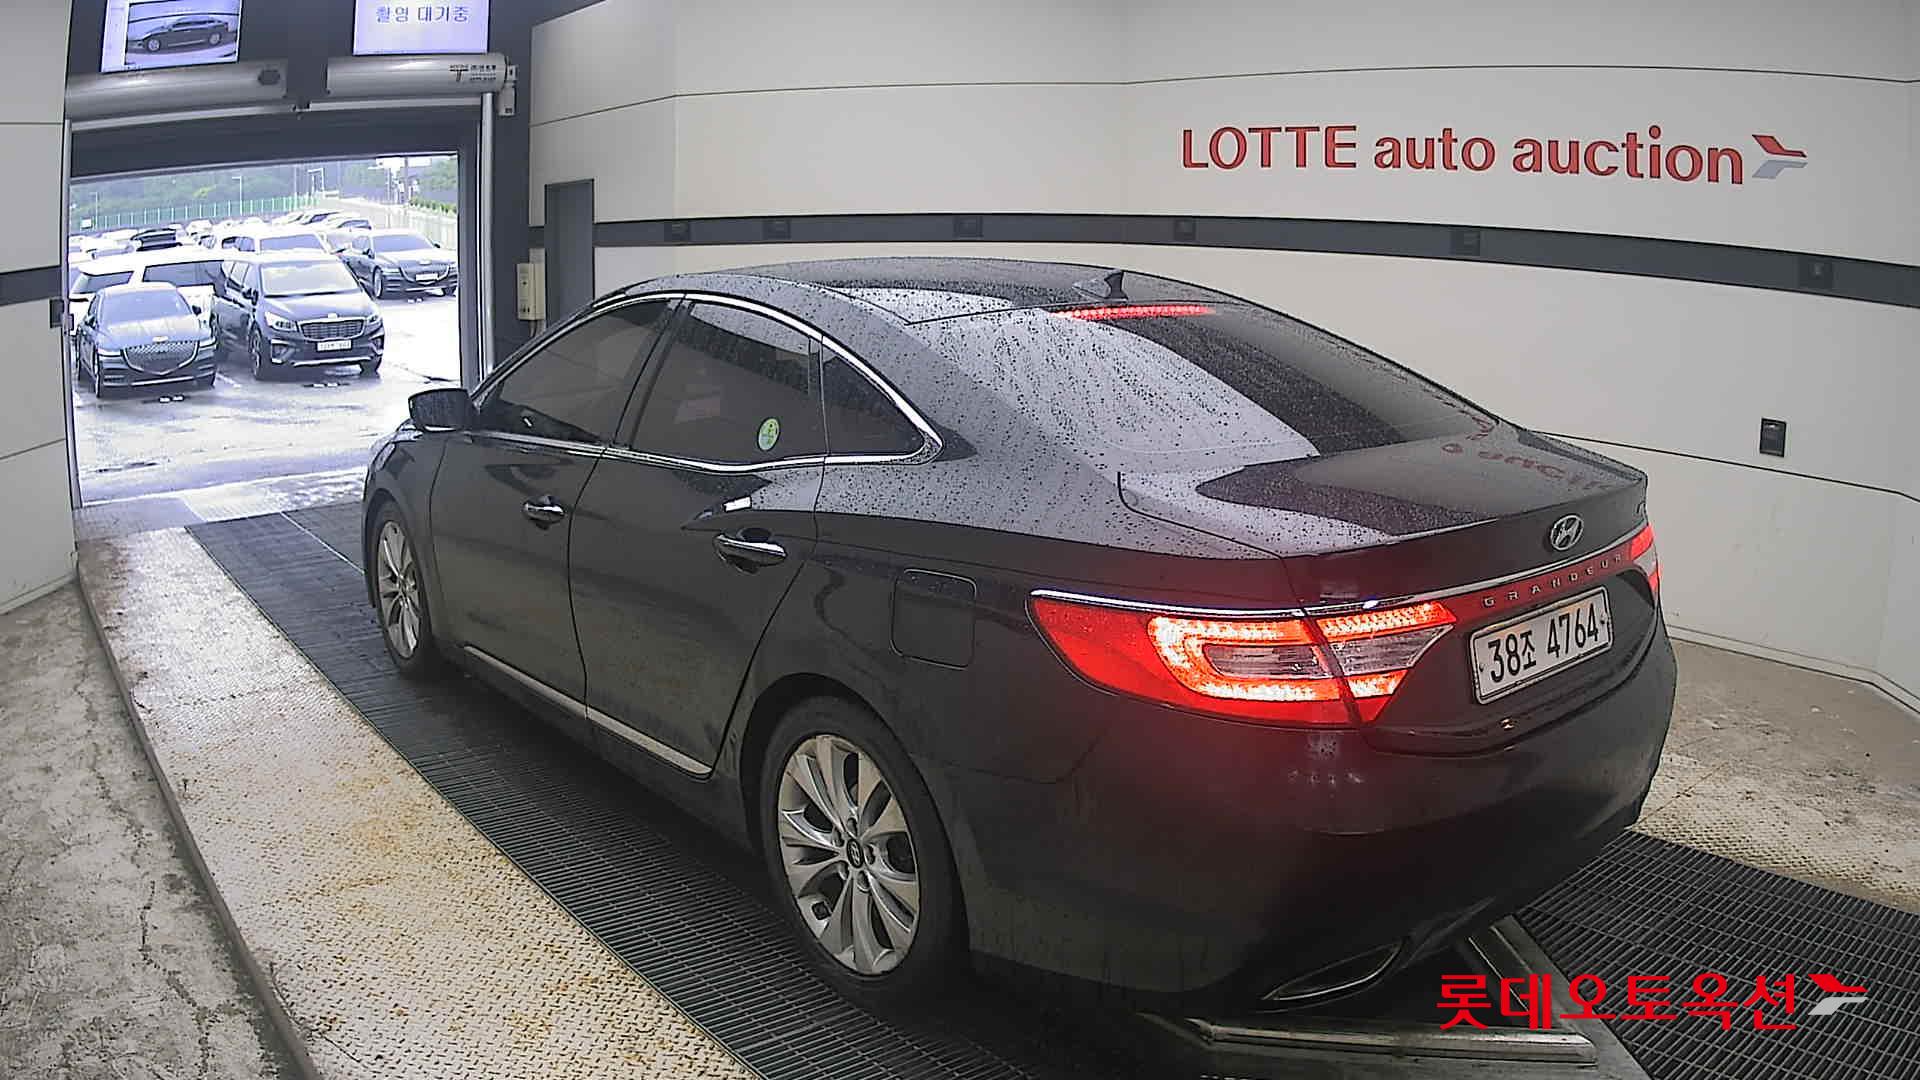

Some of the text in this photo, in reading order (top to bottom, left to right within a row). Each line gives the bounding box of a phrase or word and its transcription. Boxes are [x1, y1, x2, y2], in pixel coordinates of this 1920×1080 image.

[417, 5, 468, 23] 대기중
[1181, 125, 1743, 185] LOTTE auto auction
[1483, 553, 1623, 607] GRANDEUR
[1487, 602, 1600, 683] 38조 4764
